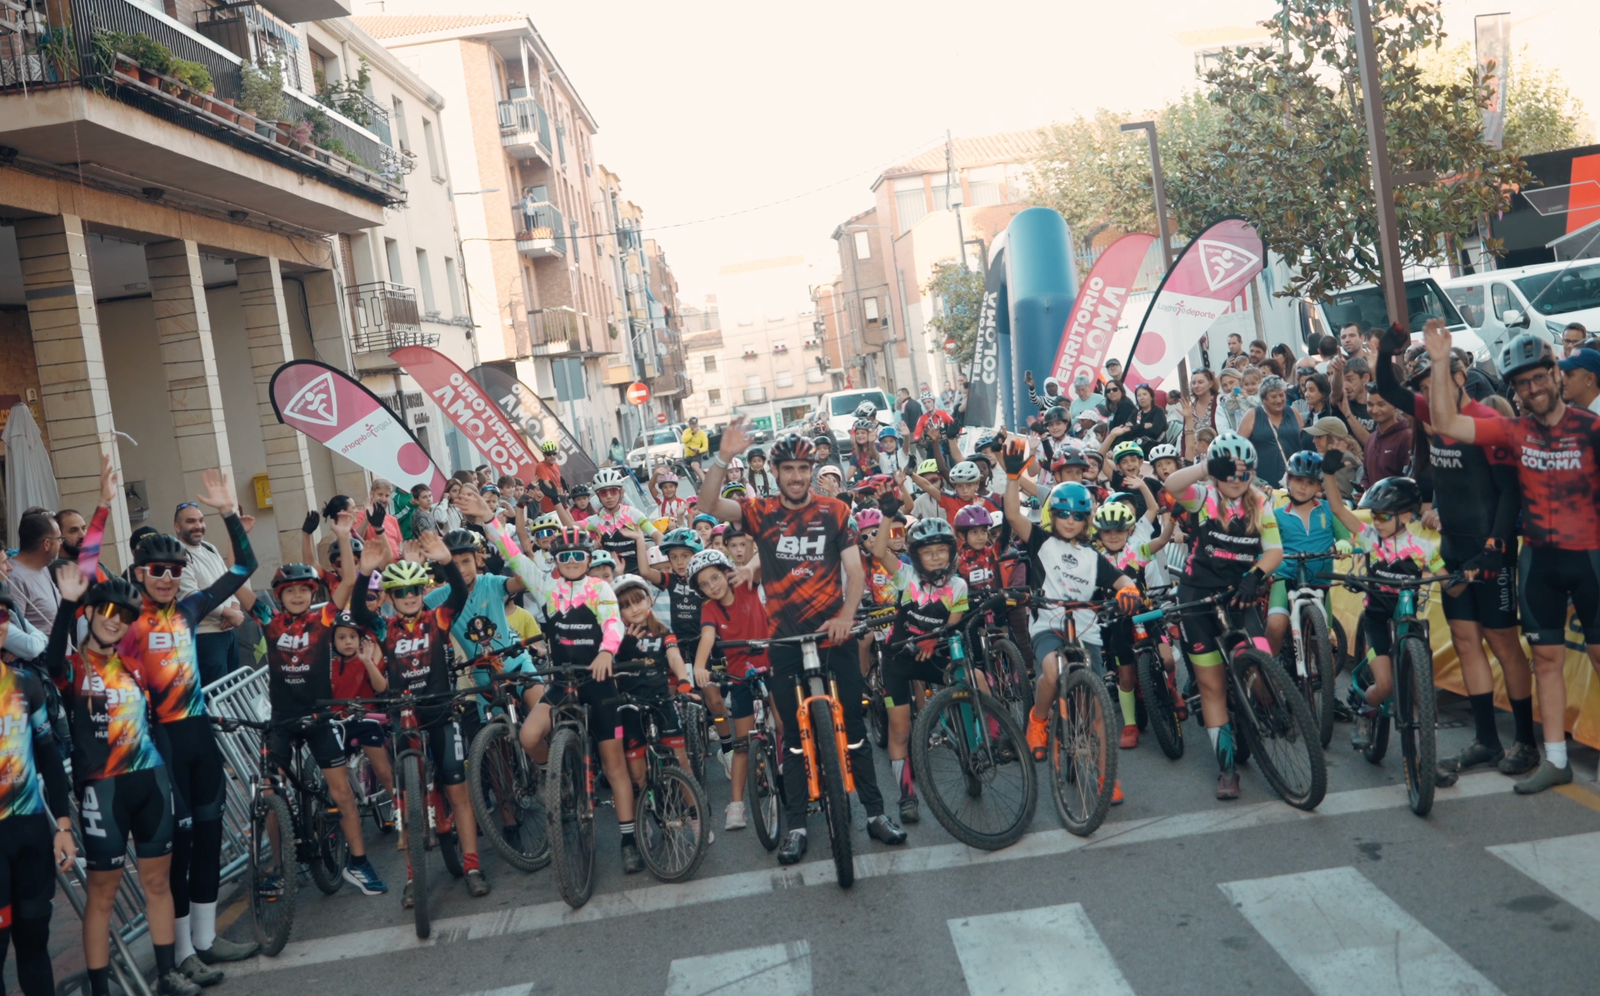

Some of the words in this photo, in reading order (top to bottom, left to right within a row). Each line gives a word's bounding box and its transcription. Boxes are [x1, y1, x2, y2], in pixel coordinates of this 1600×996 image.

[971, 291, 989, 384] TERRITORIO
[982, 291, 998, 385] COLOMA
[1520, 445, 1582, 460] TERRITORIO
[1520, 454, 1582, 471] COLOMA
[776, 533, 827, 555] BH
[1496, 567, 1510, 587] Oja
[1498, 587, 1510, 612] Auto
[148, 628, 192, 650] BH
[277, 631, 310, 649] BH
[394, 633, 430, 654] BH
[280, 663, 311, 673] victoria
[401, 665, 431, 679] victoria
[0, 713, 28, 737] H
[81, 786, 107, 838] BH
